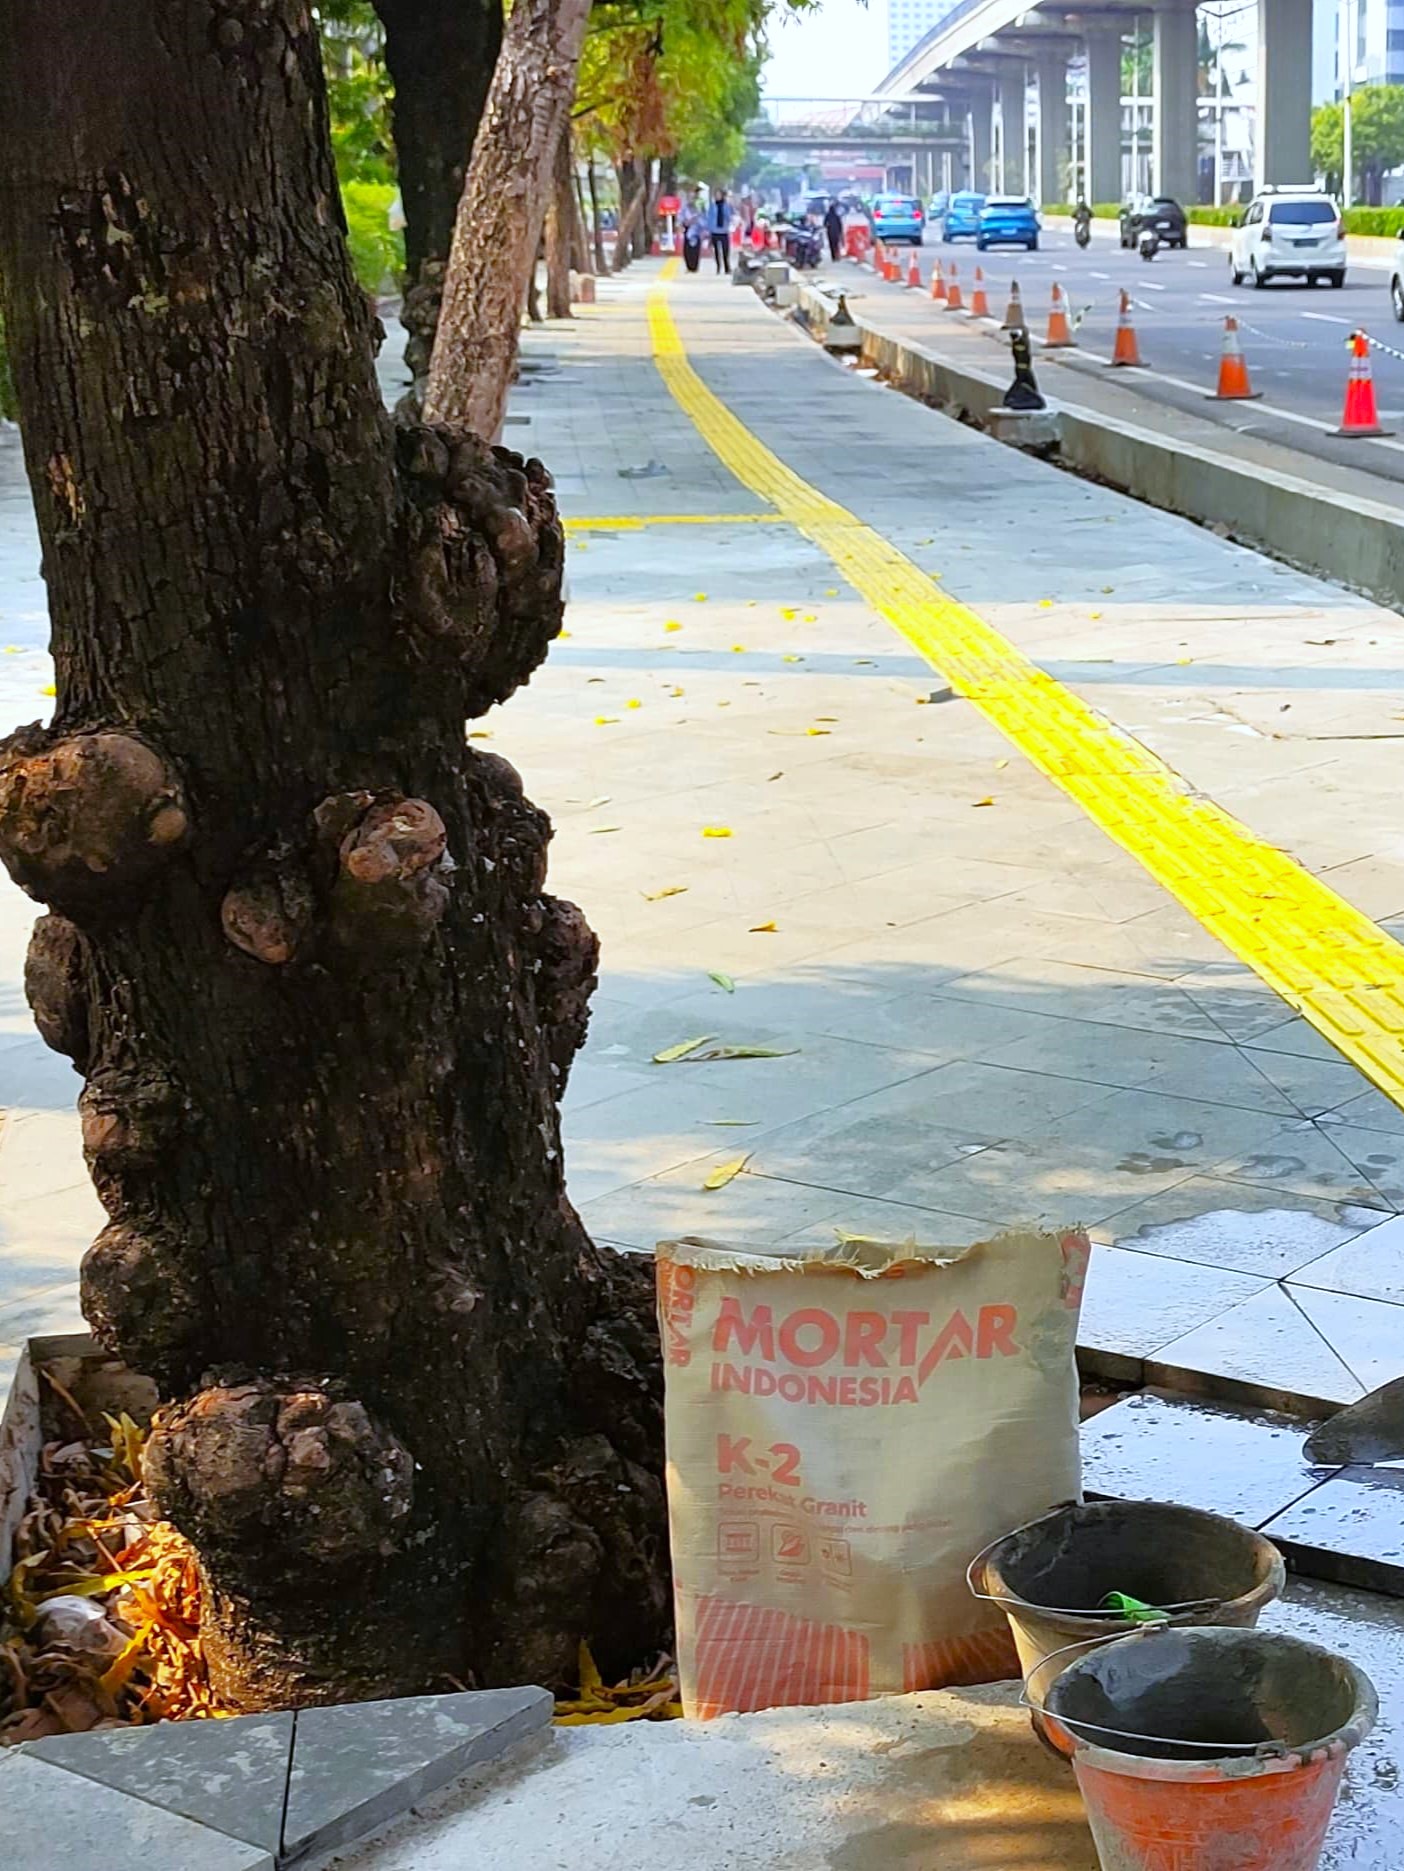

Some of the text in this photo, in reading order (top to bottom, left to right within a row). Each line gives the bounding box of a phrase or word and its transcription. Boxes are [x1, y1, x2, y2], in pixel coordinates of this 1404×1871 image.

[712, 1296, 1021, 1388] MORTAR
[710, 1362, 920, 1408] INDONESIA
[717, 1432, 801, 1487] K-2
[801, 1497, 868, 1518] Granit
